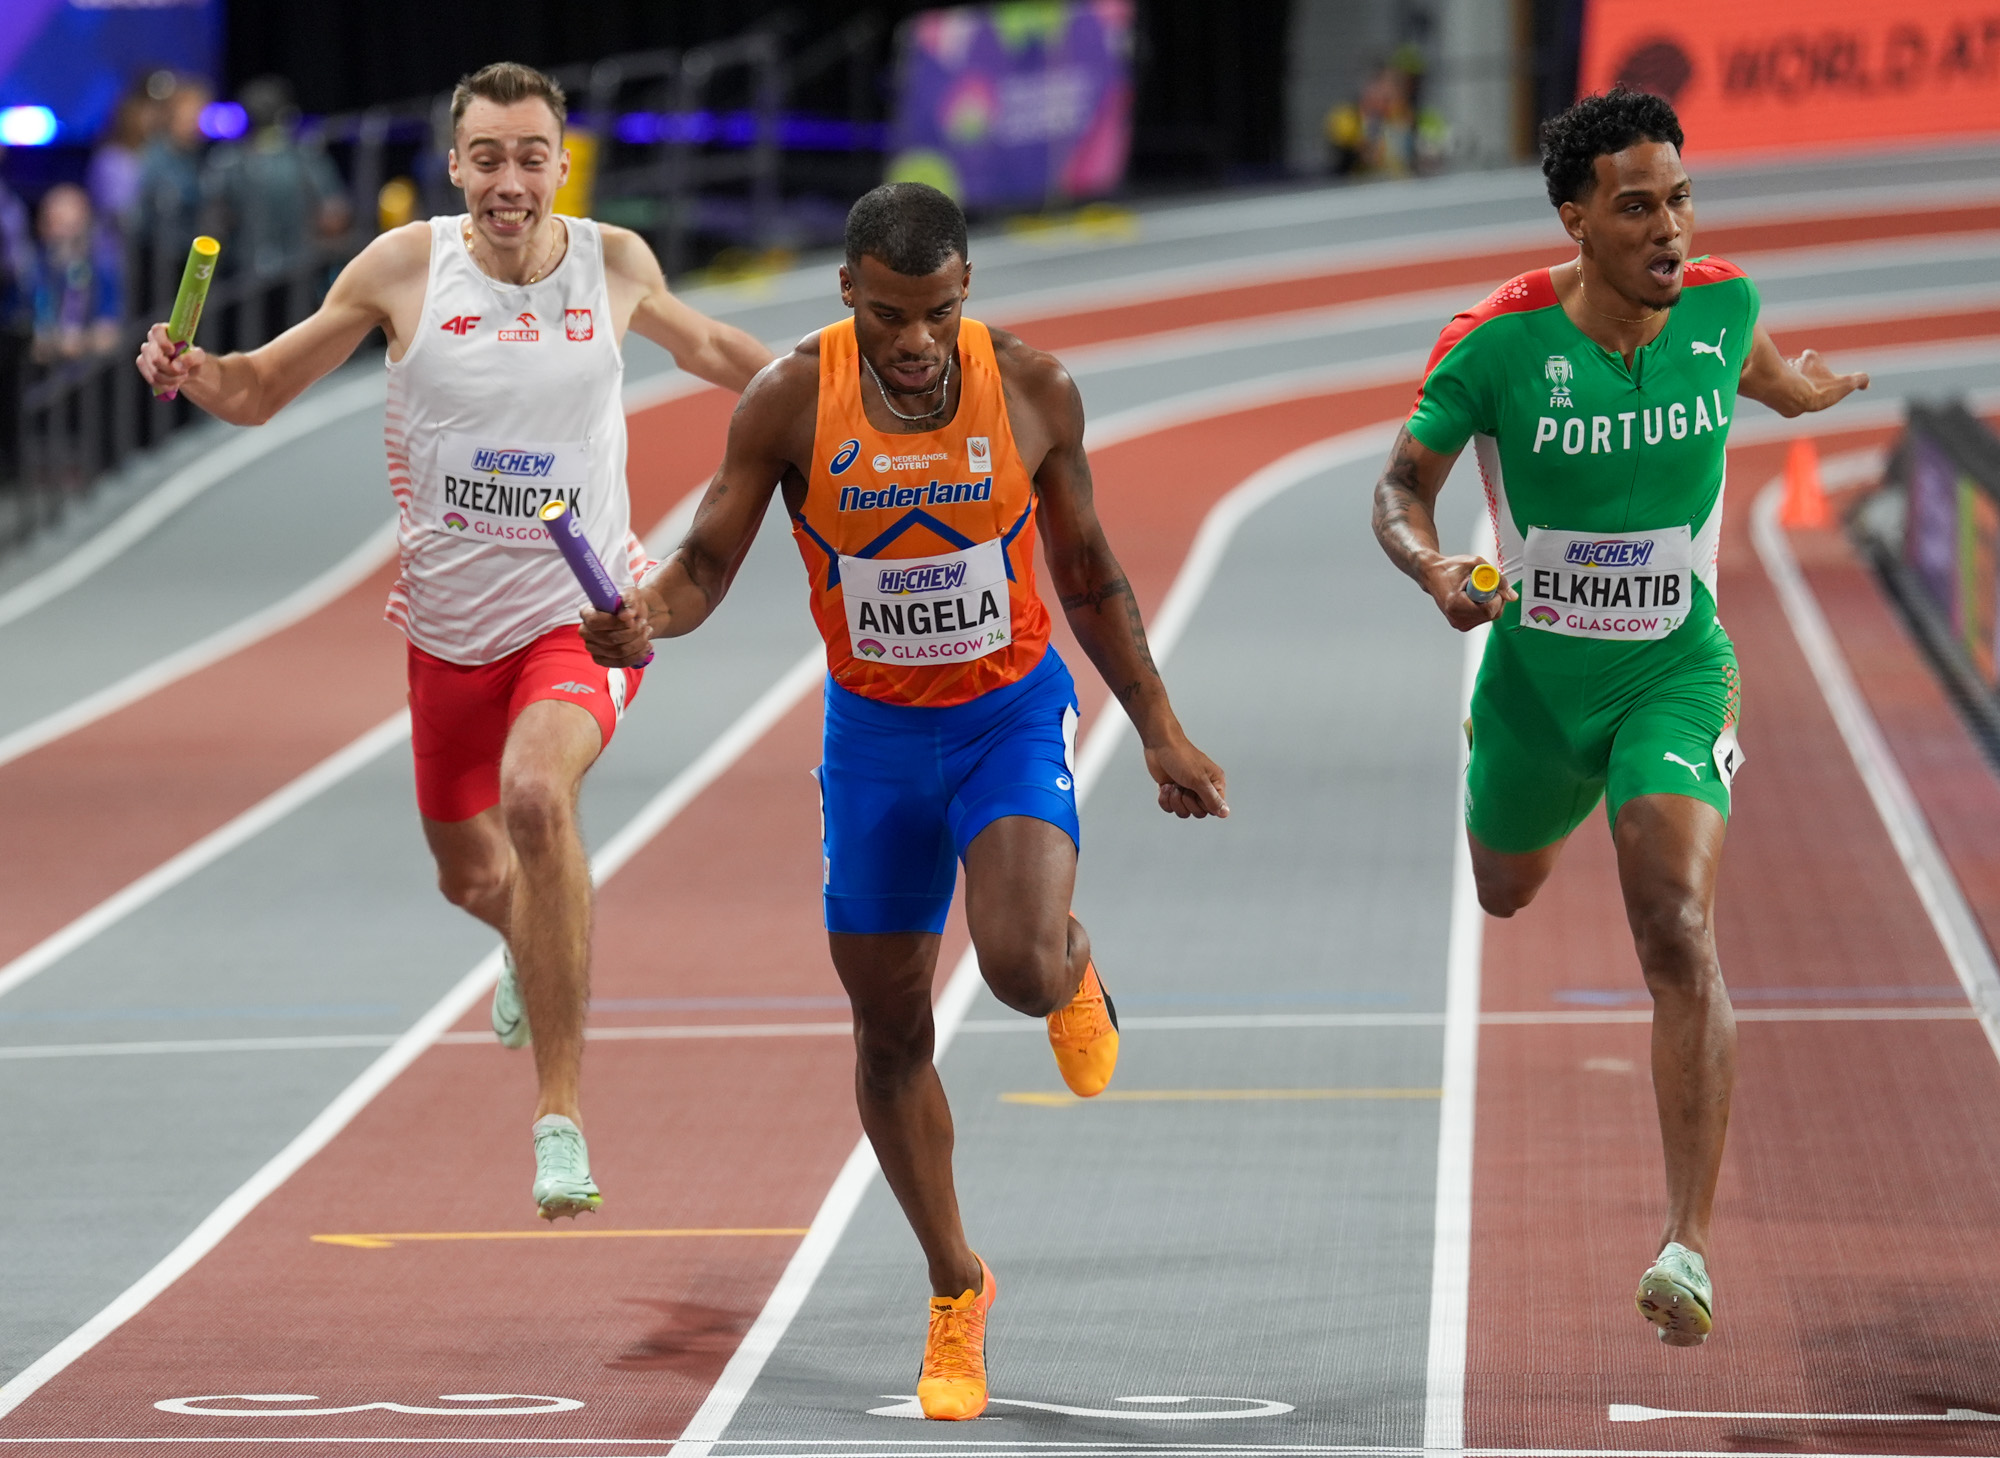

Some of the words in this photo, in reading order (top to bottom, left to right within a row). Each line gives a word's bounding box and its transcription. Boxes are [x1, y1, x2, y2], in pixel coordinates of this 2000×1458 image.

[441, 315, 481, 335] 4F
[499, 331, 537, 341] ORLEN
[1549, 396, 1574, 408] FPA
[1533, 389, 1728, 455] PORTUGAL
[471, 449, 555, 477] HI-CHEW
[892, 453, 948, 463] NEDERLANDSE
[892, 461, 930, 471] LOTERIJ
[1564, 540, 1654, 567] HI-CHEW
[879, 561, 966, 593] HI-CHEW
[1533, 569, 1680, 608] ELKHATIB
[858, 590, 1000, 636] ANGELA
[1566, 614, 1659, 632] GLASGOW
[892, 636, 984, 659] GLASGOW
[987, 629, 1005, 646] 24
[551, 681, 595, 694] 4F
